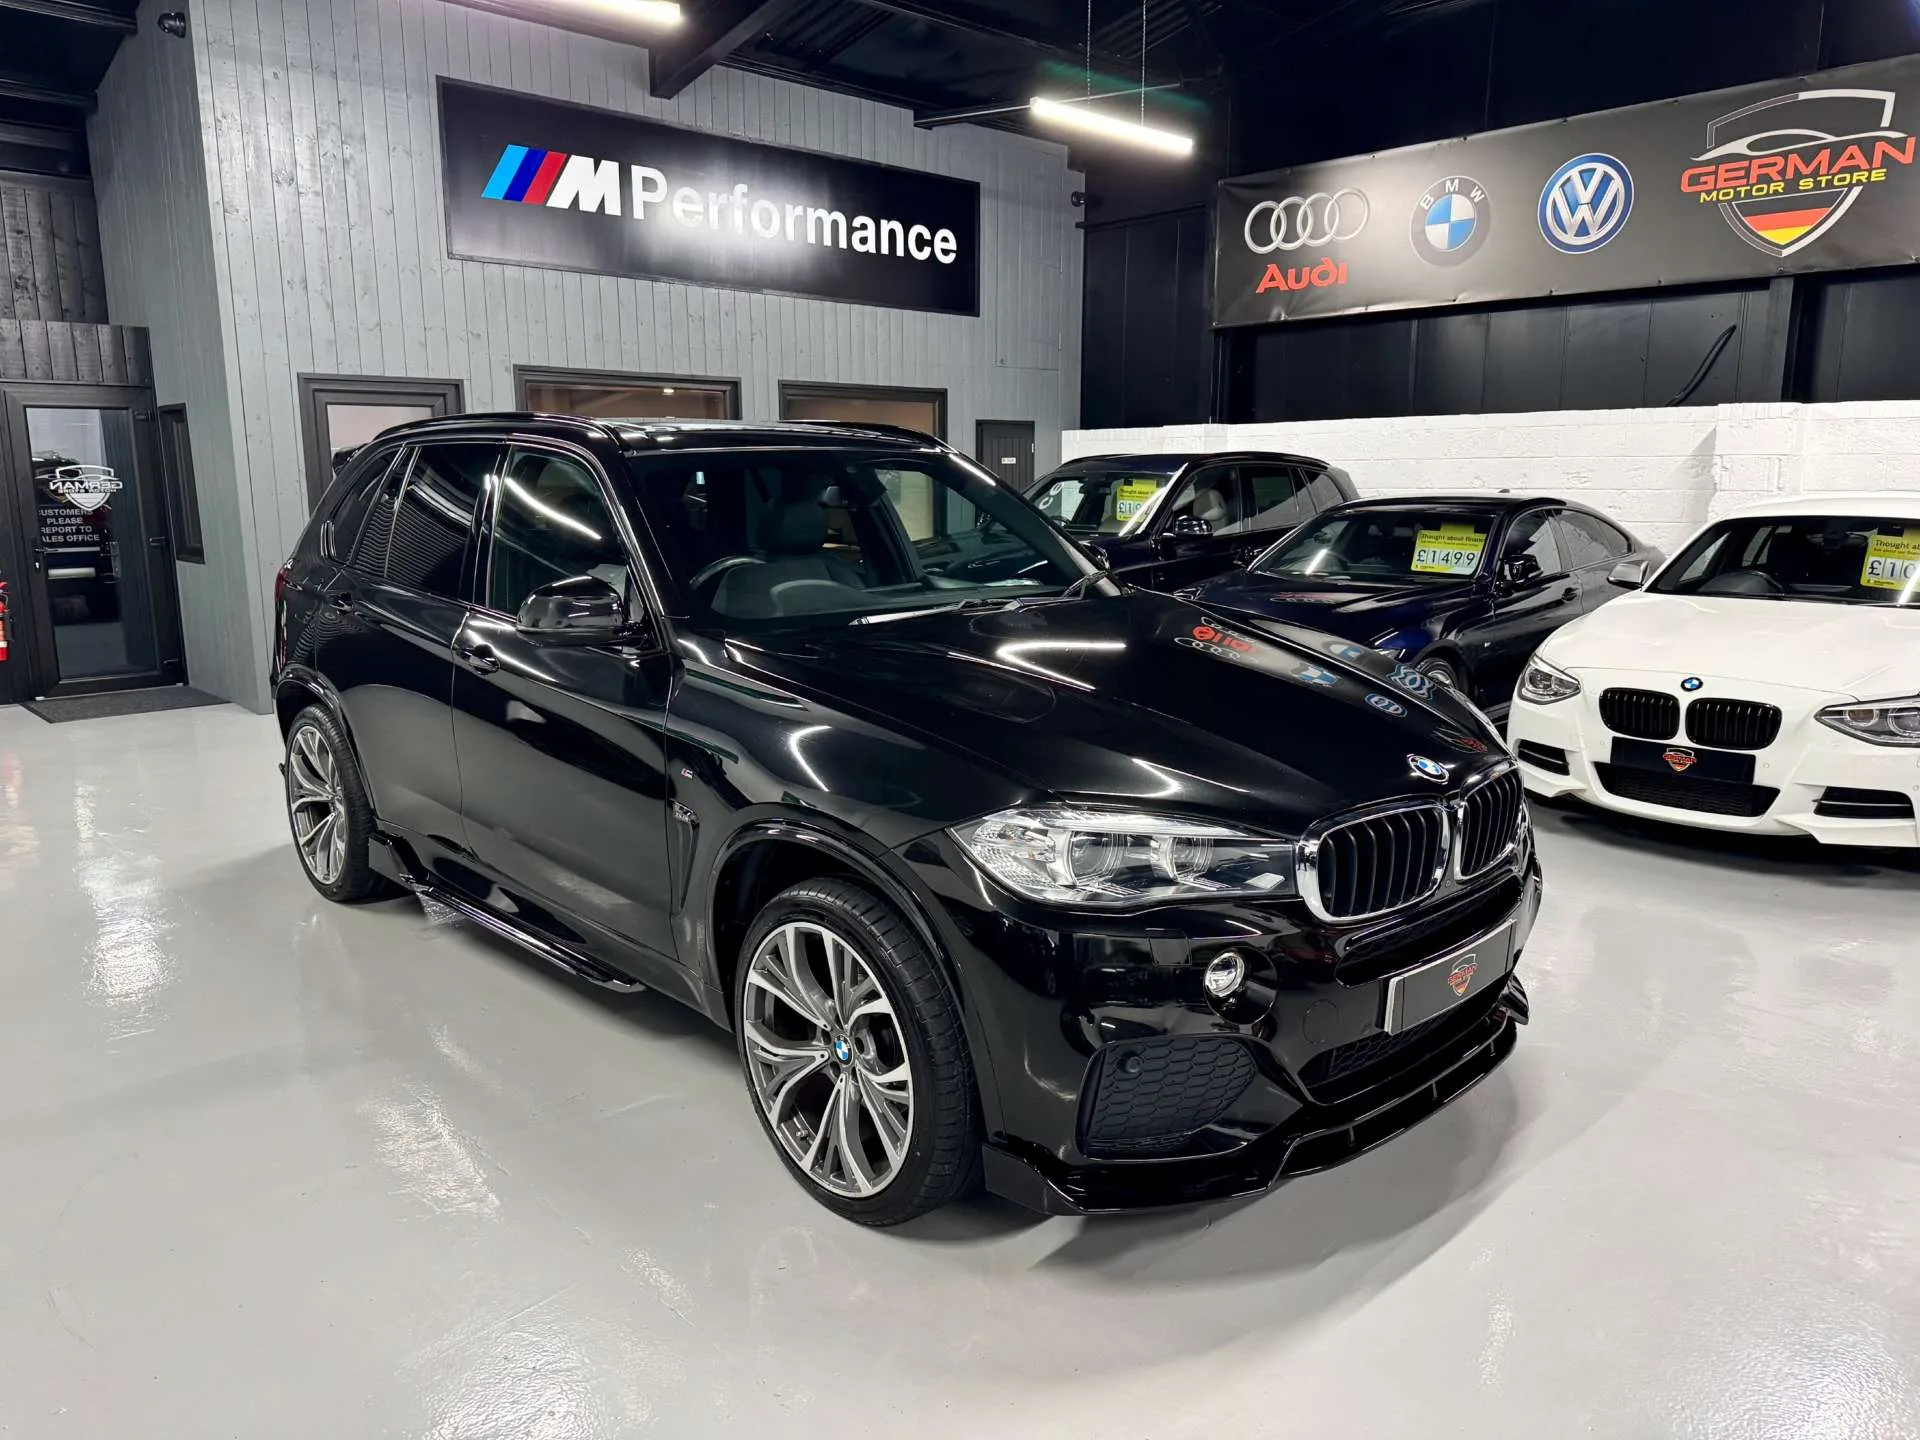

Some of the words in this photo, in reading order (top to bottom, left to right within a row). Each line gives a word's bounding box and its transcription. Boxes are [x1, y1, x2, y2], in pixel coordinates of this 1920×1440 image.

[1680, 136, 1917, 193] GERMAN
[1419, 178, 1486, 211] BMW
[1700, 182, 1785, 204] MOTOR
[1798, 168, 1888, 190] STORE
[546, 153, 622, 217] M
[630, 164, 958, 265] Performance
[1255, 257, 1347, 294] Audi
[38, 508, 93, 516] USTOMERS
[46, 517, 84, 525] PLEASE
[79, 525, 92, 533] TO
[42, 534, 65, 542] LES
[66, 534, 100, 542] OFFICE
[1875, 539, 1910, 550] Thought
[1416, 549, 1476, 566] £1499
